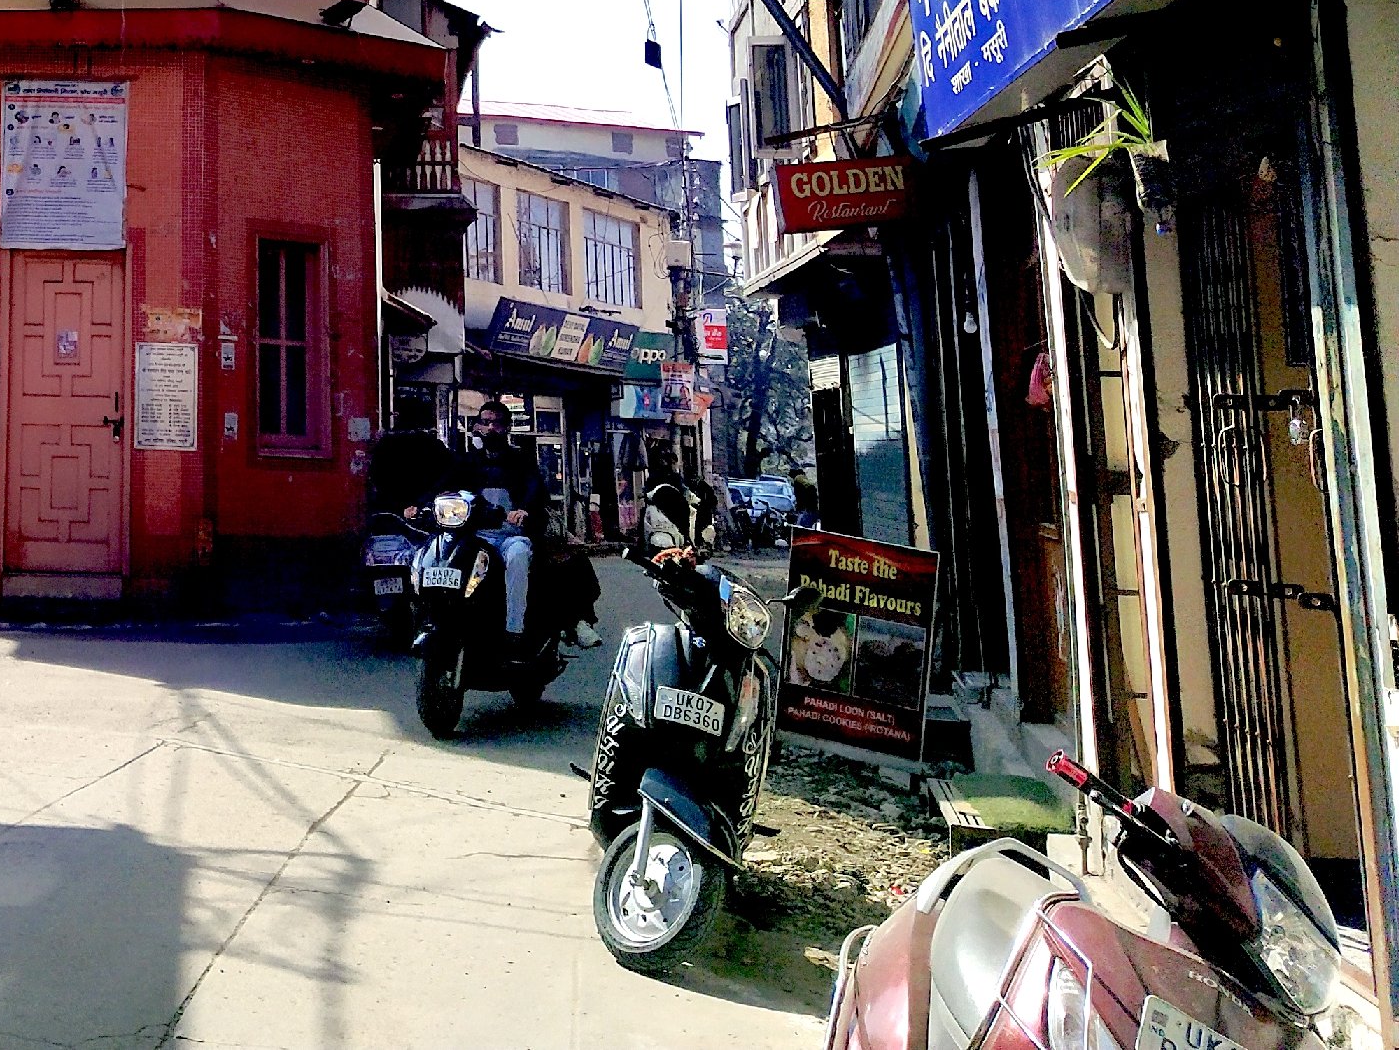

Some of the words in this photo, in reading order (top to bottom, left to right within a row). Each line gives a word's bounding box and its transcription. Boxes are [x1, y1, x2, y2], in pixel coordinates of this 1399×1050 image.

[790, 165, 905, 198] GOLDEN
[807, 198, 897, 222] Restaurant
[828, 549, 869, 574] Taste
[872, 556, 897, 580] the
[854, 585, 921, 616] Flavours
[676, 692, 714, 714] UK07
[787, 706, 821, 720] PAHADI
[804, 696, 838, 711] PAHADI
[663, 704, 720, 732] DB6360
